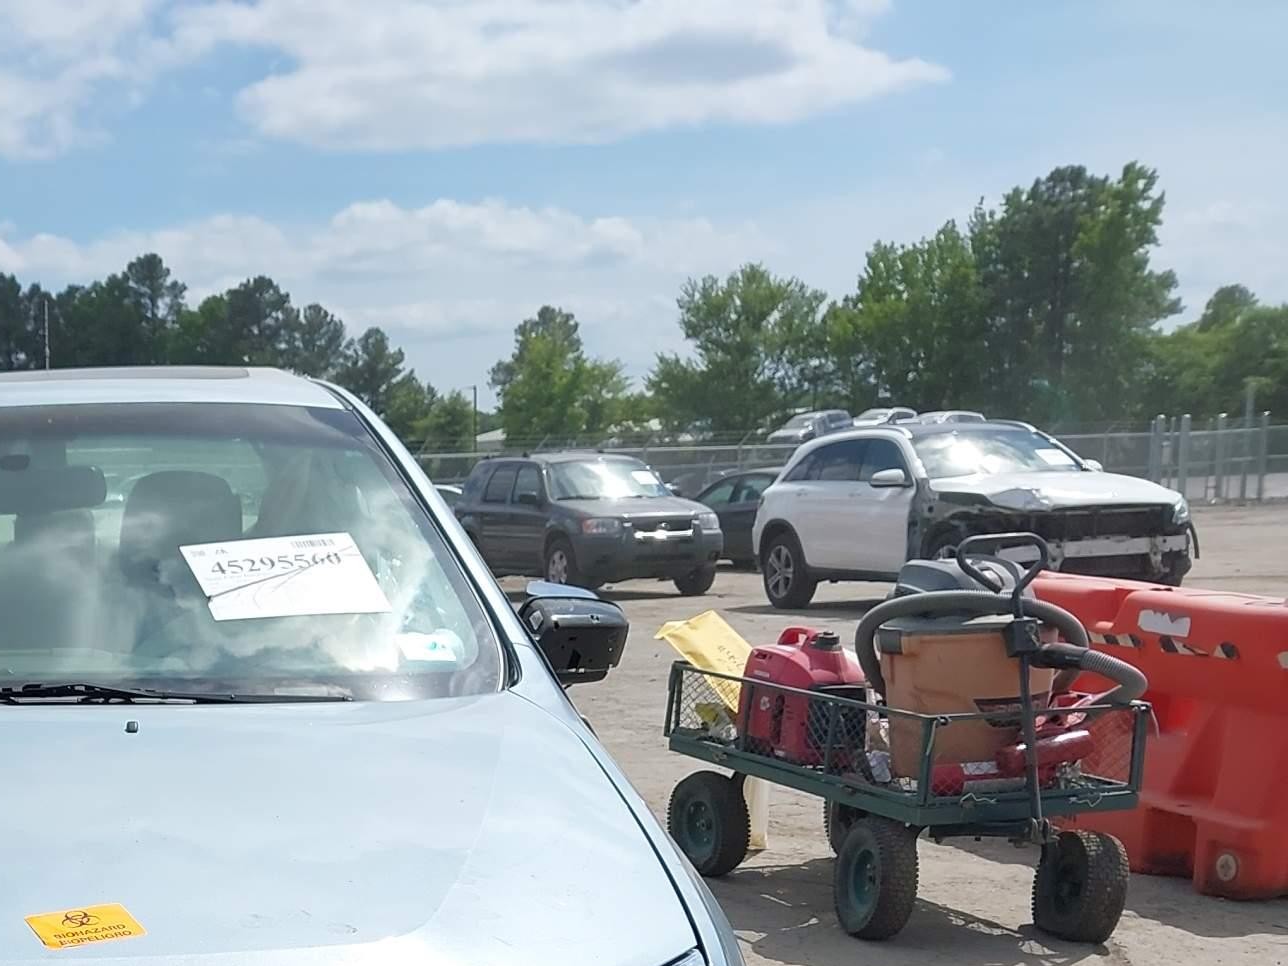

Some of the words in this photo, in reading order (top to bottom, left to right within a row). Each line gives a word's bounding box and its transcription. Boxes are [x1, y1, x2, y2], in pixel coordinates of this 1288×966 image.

[211, 552, 342, 575] 45295560
[54, 924, 126, 939] BIOHAZARD
[59, 931, 131, 945] BIOPELIGRO
